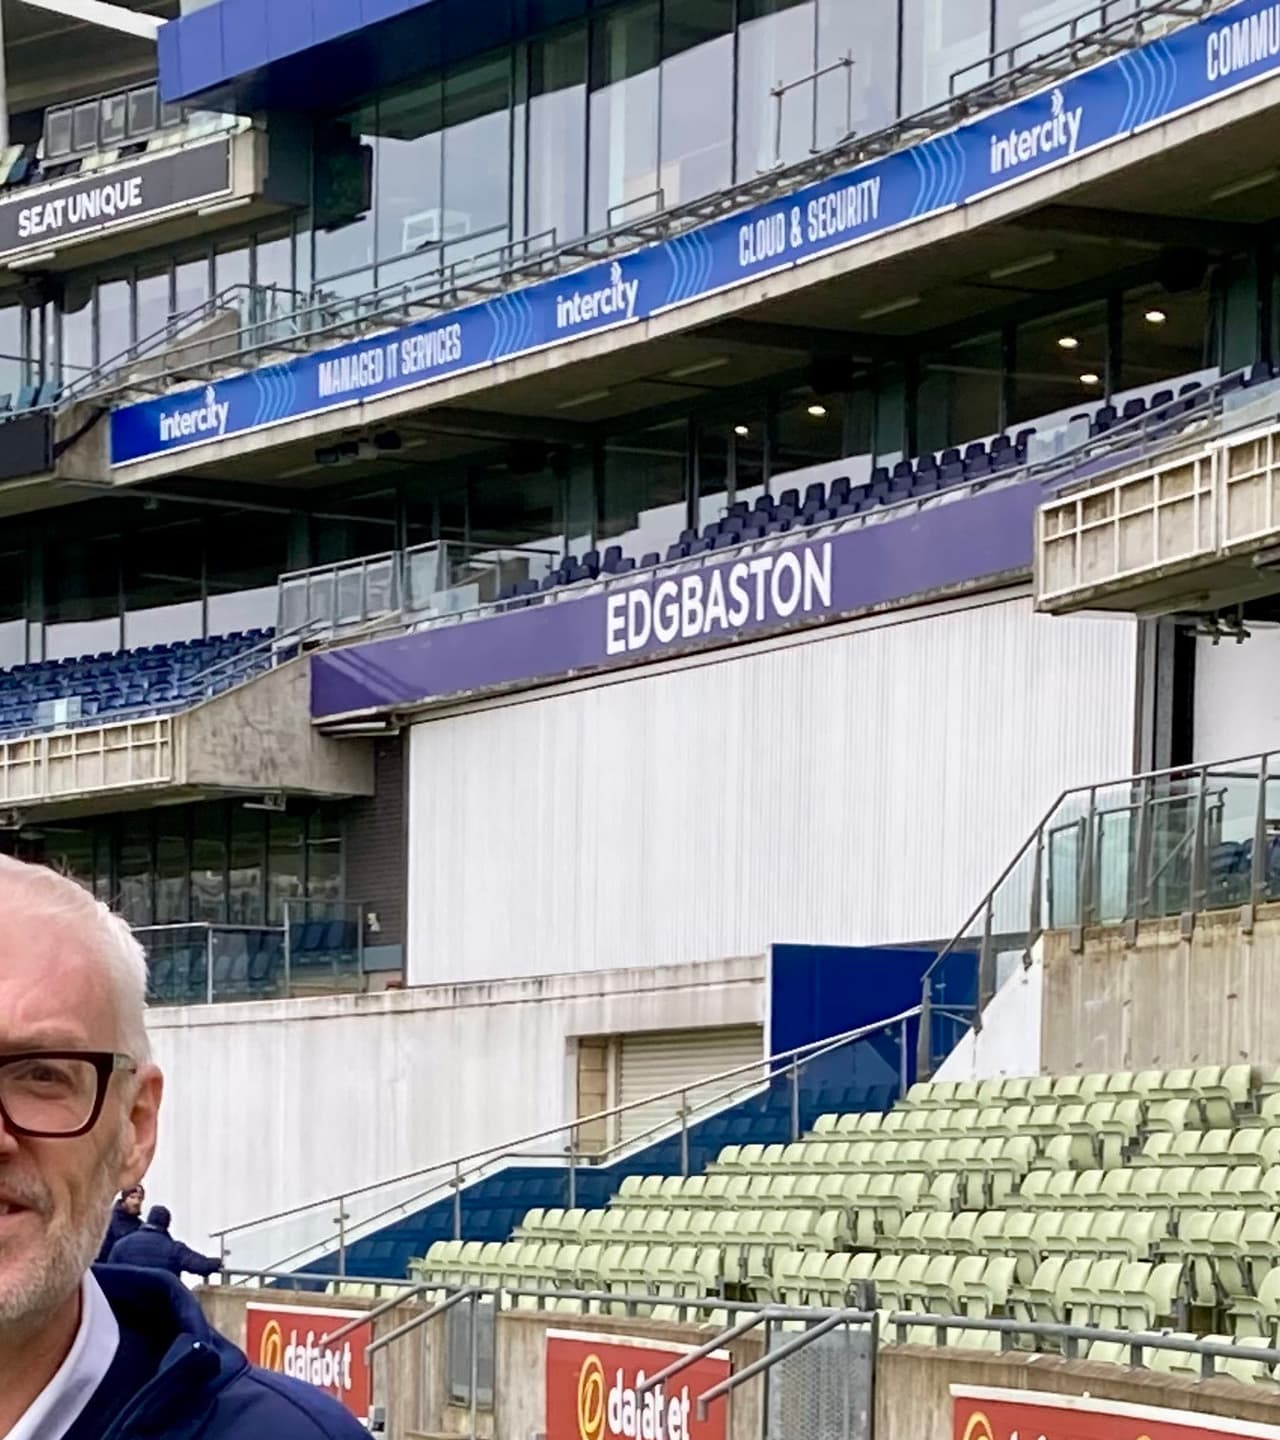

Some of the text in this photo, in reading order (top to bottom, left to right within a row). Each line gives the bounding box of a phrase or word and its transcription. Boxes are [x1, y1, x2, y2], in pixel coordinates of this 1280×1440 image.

[990, 88, 1083, 174] intercity
[18, 176, 143, 238] SEAT UNIQUE
[739, 176, 880, 267] CLOUD & SECURITY
[557, 261, 638, 328] intercity
[319, 322, 462, 398] MANAGED IT SERVICES
[160, 386, 228, 441] intercity
[607, 543, 832, 655] EDGBASTON
